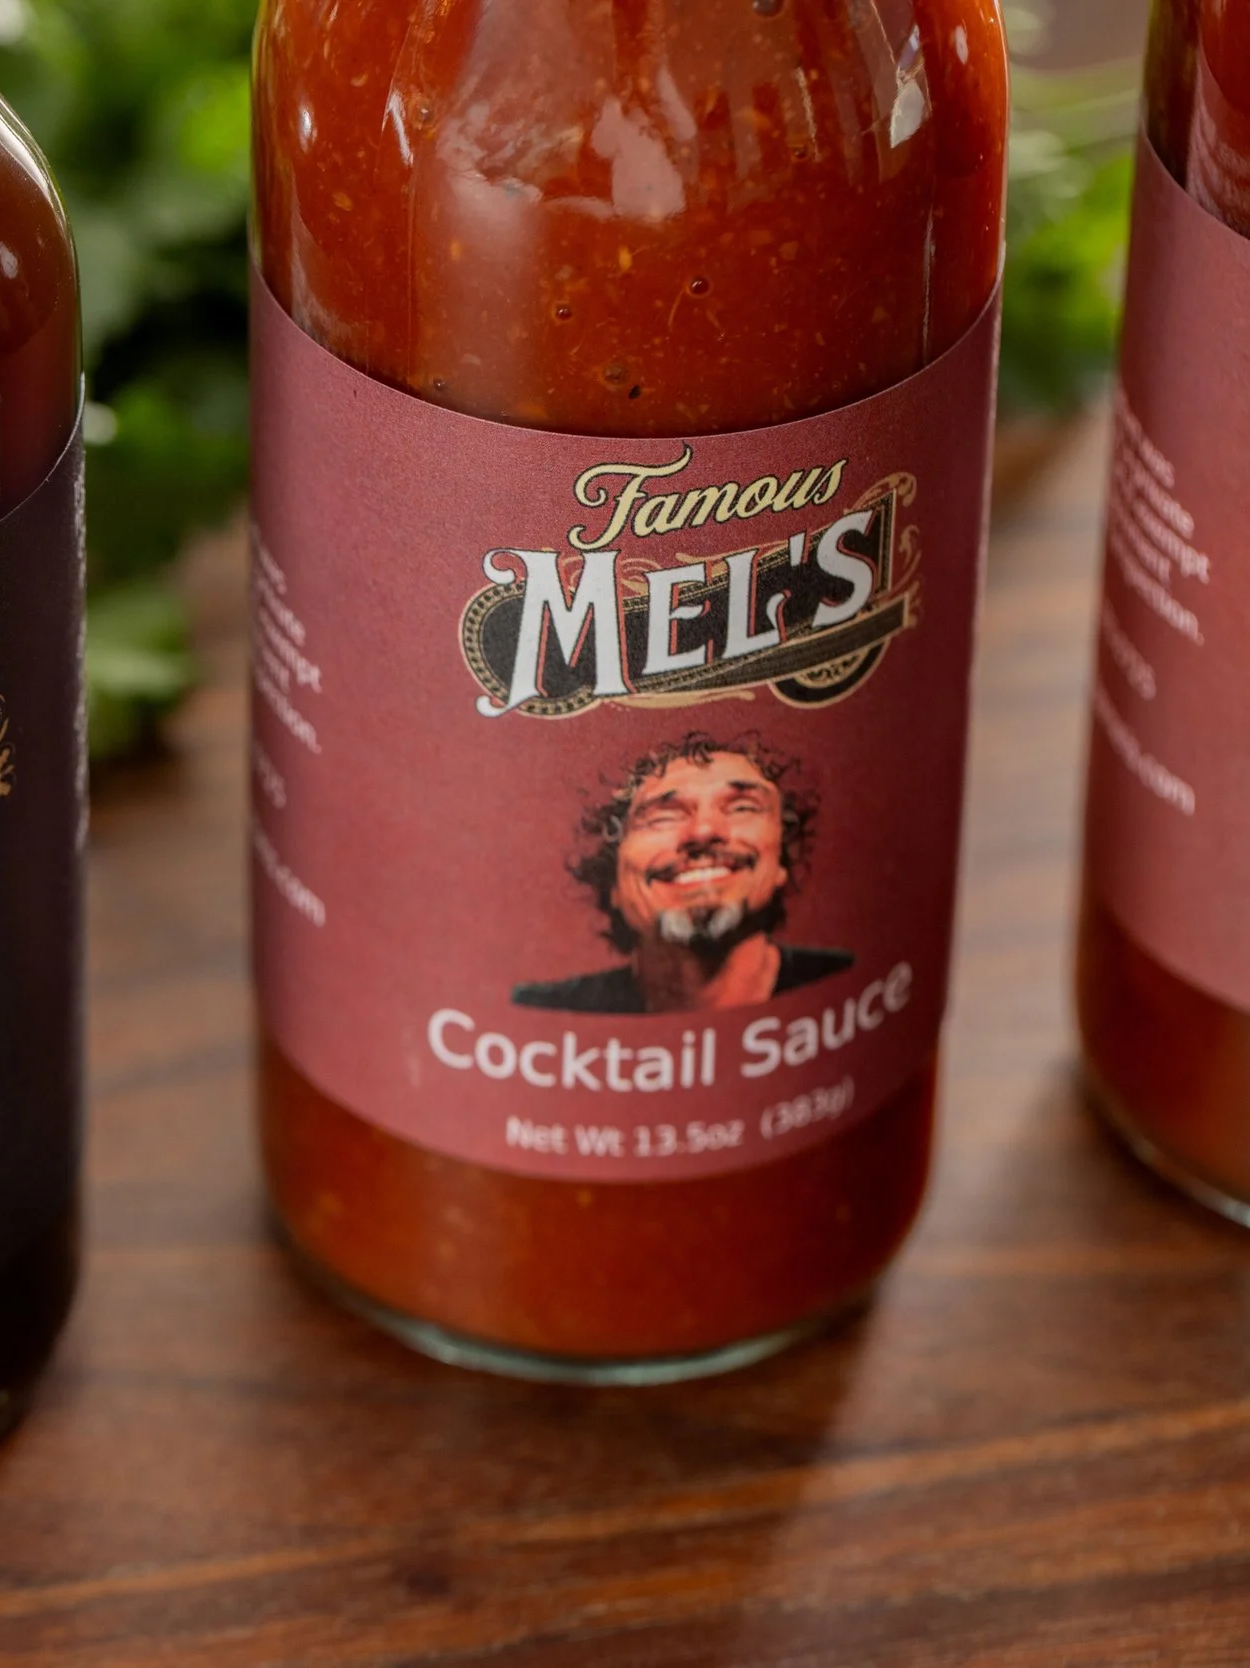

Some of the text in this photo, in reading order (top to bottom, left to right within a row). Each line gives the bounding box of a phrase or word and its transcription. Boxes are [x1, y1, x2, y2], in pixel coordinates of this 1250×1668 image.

[567, 440, 848, 550] Famous
[476, 509, 876, 718] MEL'S
[427, 961, 914, 1092] Cocktail Sauce
[505, 1079, 855, 1157] Net Wt 13.5oz (383g)
